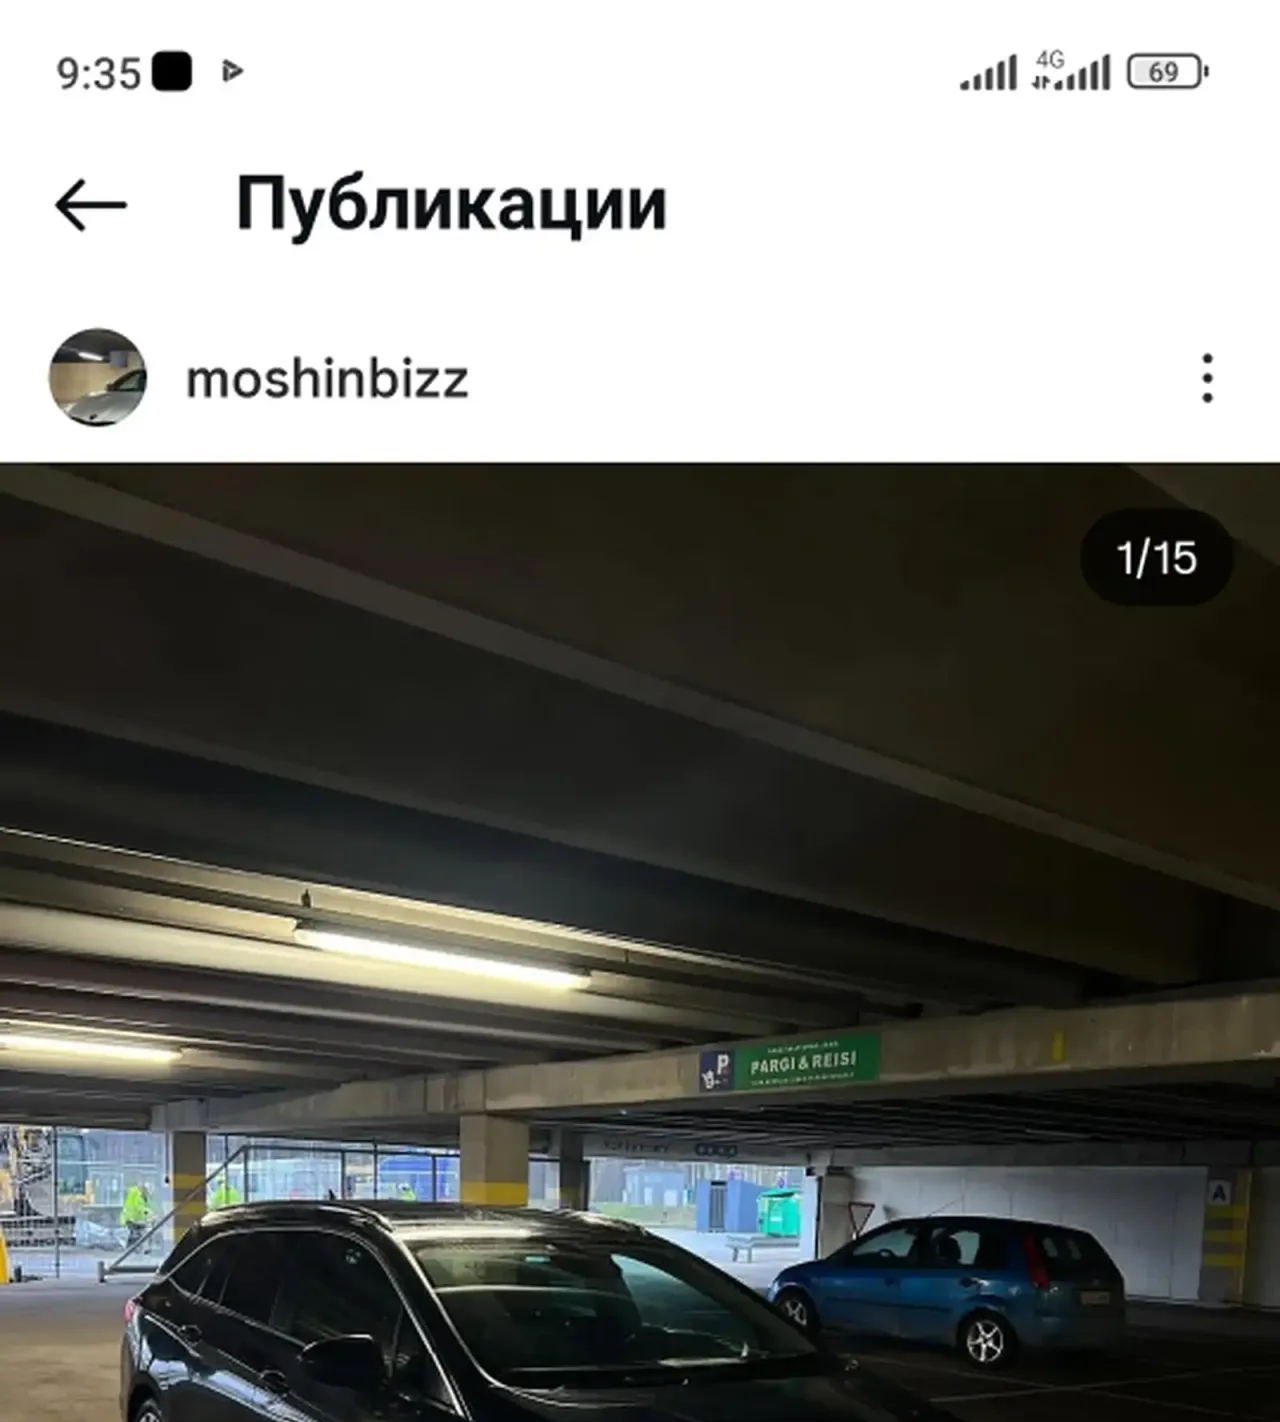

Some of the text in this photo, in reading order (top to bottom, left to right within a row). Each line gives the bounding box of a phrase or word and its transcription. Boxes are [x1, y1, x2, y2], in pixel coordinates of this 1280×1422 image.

[1036, 49, 1065, 69] 4G
[1149, 61, 1179, 83] 69
[57, 56, 140, 91] 9:35
[238, 170, 667, 245] Публикации
[187, 356, 469, 399] moshinbizz
[1116, 535, 1198, 580] 1/15
[716, 1054, 730, 1075] P
[750, 1050, 857, 1076] PARGI & REISI
[1212, 1183, 1227, 1202] A
